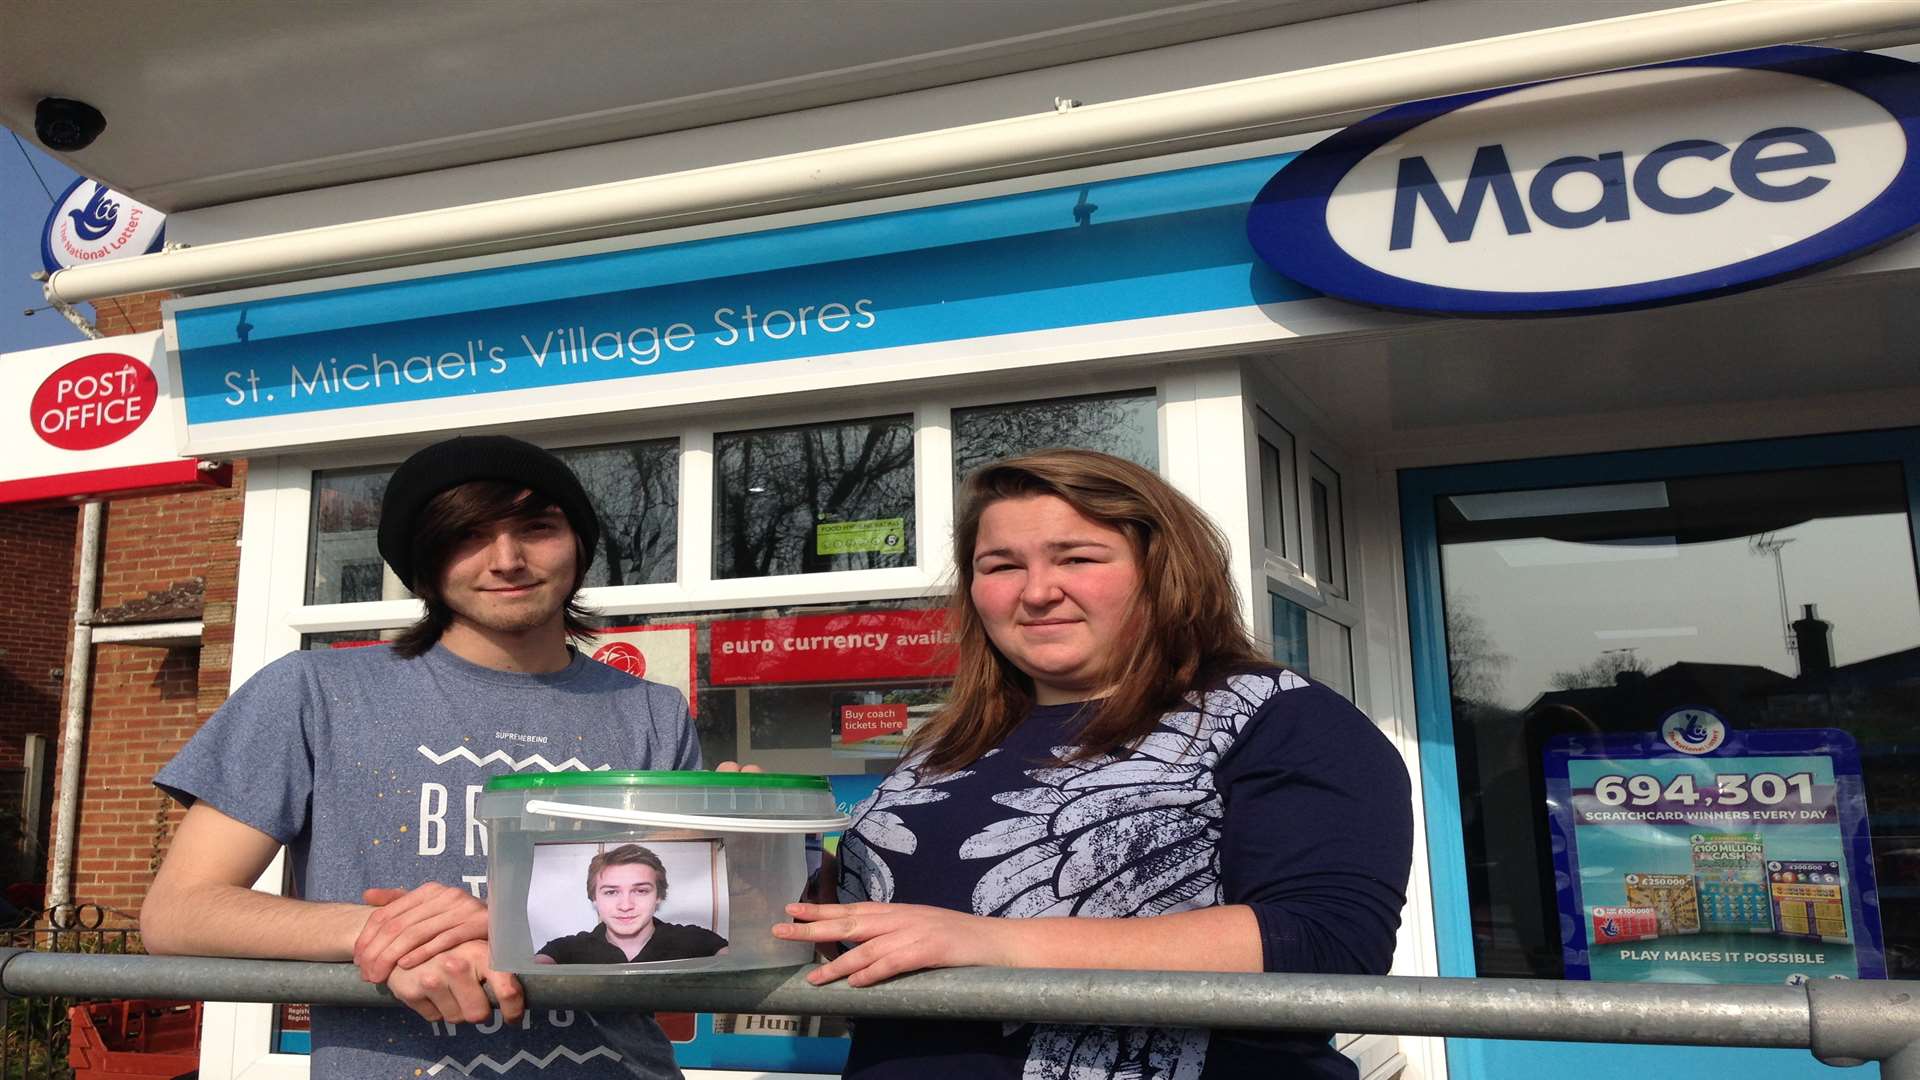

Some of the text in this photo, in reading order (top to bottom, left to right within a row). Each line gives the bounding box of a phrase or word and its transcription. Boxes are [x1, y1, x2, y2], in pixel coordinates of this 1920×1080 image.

[1389, 126, 1836, 252] Mace
[63, 240, 111, 260] National
[111, 207, 144, 250] Lottery
[224, 299, 876, 406] St. Michael's Village Stores
[57, 369, 135, 404] POST
[40, 396, 141, 434] OFFICE
[721, 638, 775, 655] euro
[783, 632, 889, 652] currency
[845, 709, 895, 720] Buy coach
[845, 720, 904, 730] tickets here
[1595, 773, 1813, 807] 694,301
[1585, 810, 1828, 822] SCRATCHCARD WINNERS EVERY DAY
[1712, 852, 1746, 861] CASH
[1719, 843, 1762, 853] MILLION
[1620, 950, 1825, 964] PLAY MAKES IT POSSIBLE
